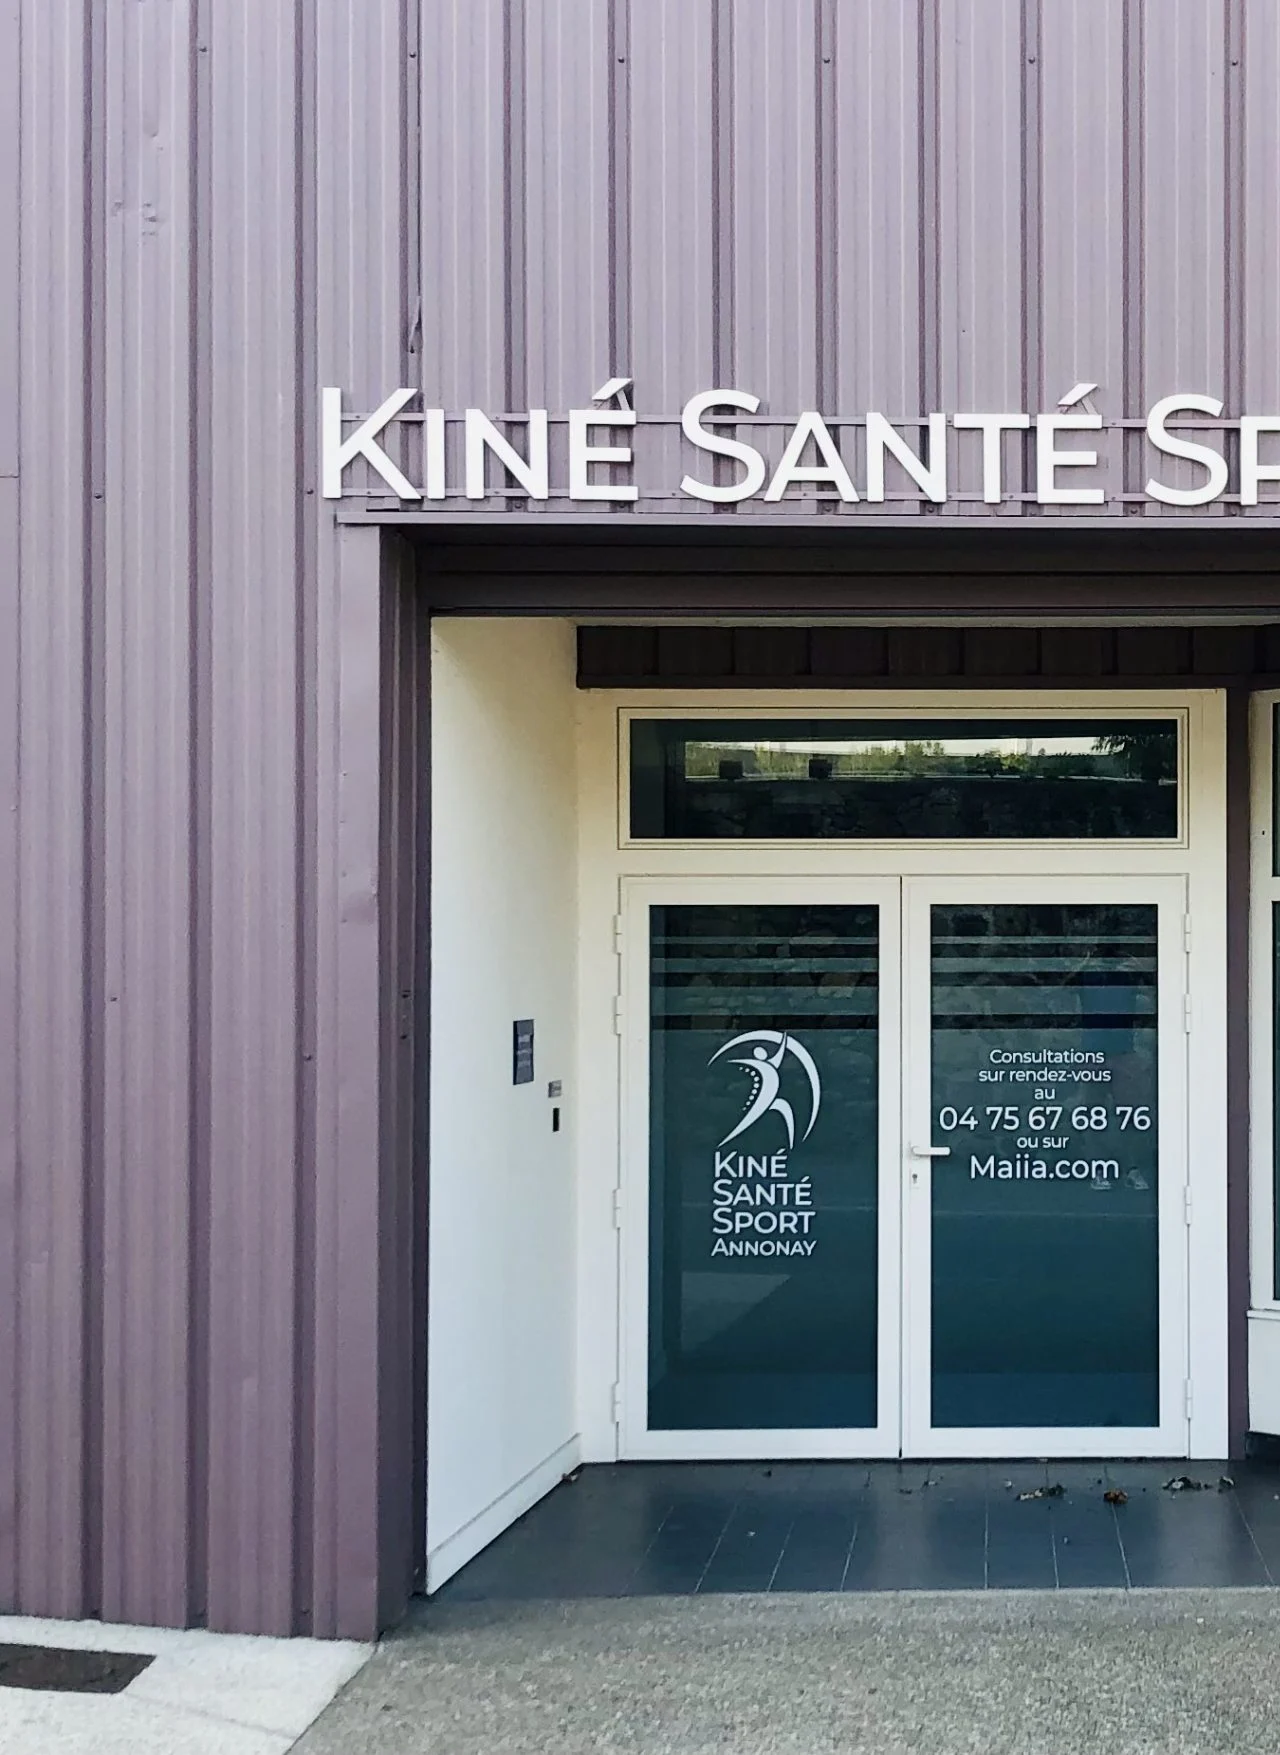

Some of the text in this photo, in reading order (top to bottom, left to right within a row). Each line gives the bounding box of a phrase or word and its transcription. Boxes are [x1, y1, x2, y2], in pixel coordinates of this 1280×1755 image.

[322, 377, 639, 501] KINÉ
[680, 382, 1105, 504] SANTÉ
[989, 1048, 1105, 1064] Consultations
[978, 1066, 1112, 1082] sur rendez-vous
[1034, 1088, 1056, 1100] au
[939, 1106, 1151, 1131] 04 75 67 68 76
[1016, 1136, 1070, 1149] ou sur
[714, 1148, 788, 1178] KINÉ
[970, 1153, 1119, 1179] Maiia.com
[712, 1175, 812, 1206] SANTÉ
[712, 1207, 816, 1234] SPORT
[711, 1237, 817, 1257] ANNONAY
